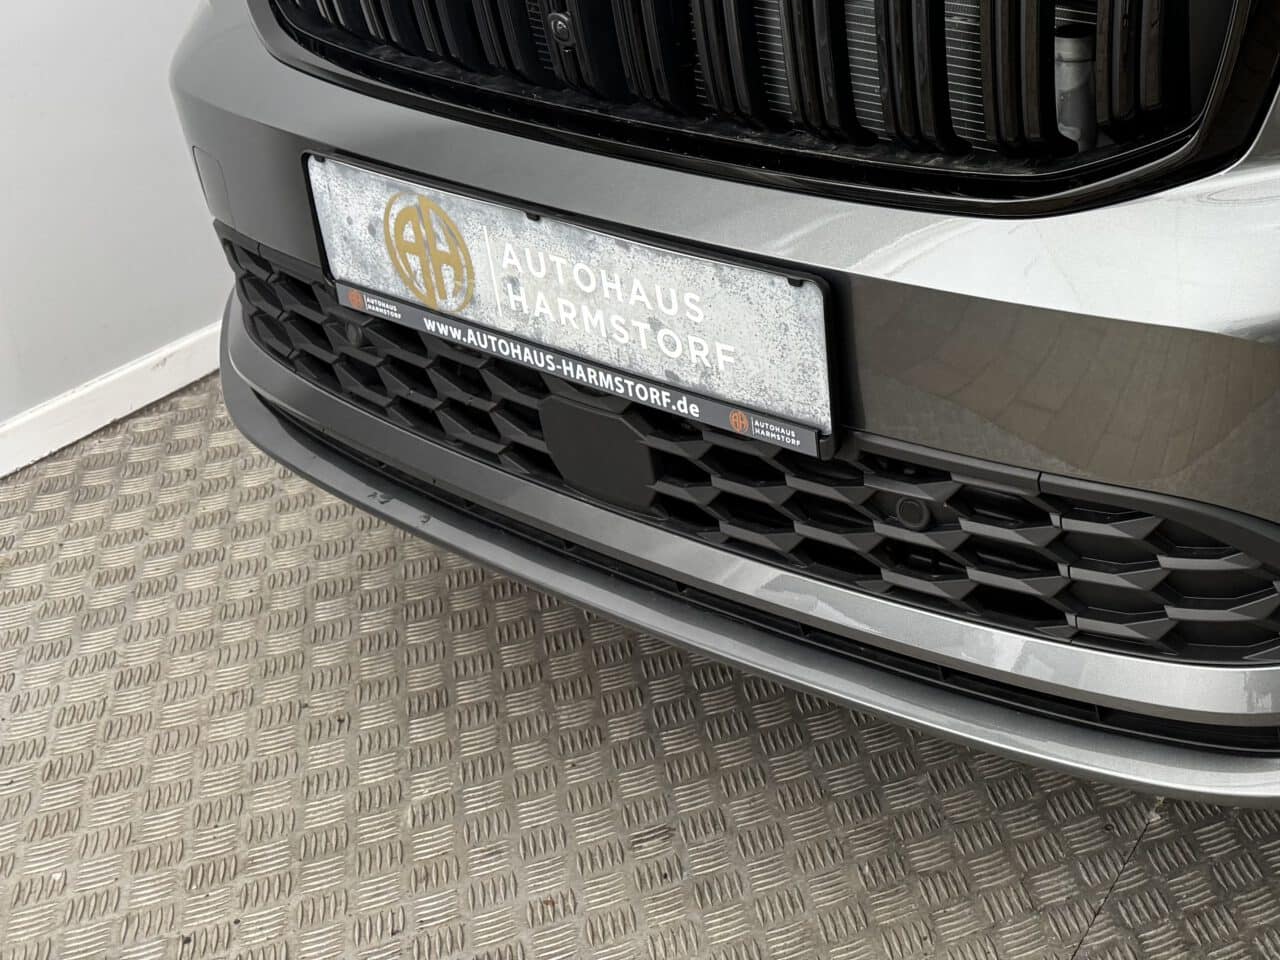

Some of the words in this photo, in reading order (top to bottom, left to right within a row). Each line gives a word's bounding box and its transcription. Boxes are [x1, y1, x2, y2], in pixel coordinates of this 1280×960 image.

[366, 297, 398, 312] AUTOHAUS
[502, 243, 705, 323] AUTOHAUS
[507, 283, 736, 372] HARMSTORF
[423, 317, 700, 418] www.AUTOHAUS-HARMSTORF.de
[754, 419, 796, 438] AUTOHAUS
[755, 428, 801, 447] HARMSTORF
